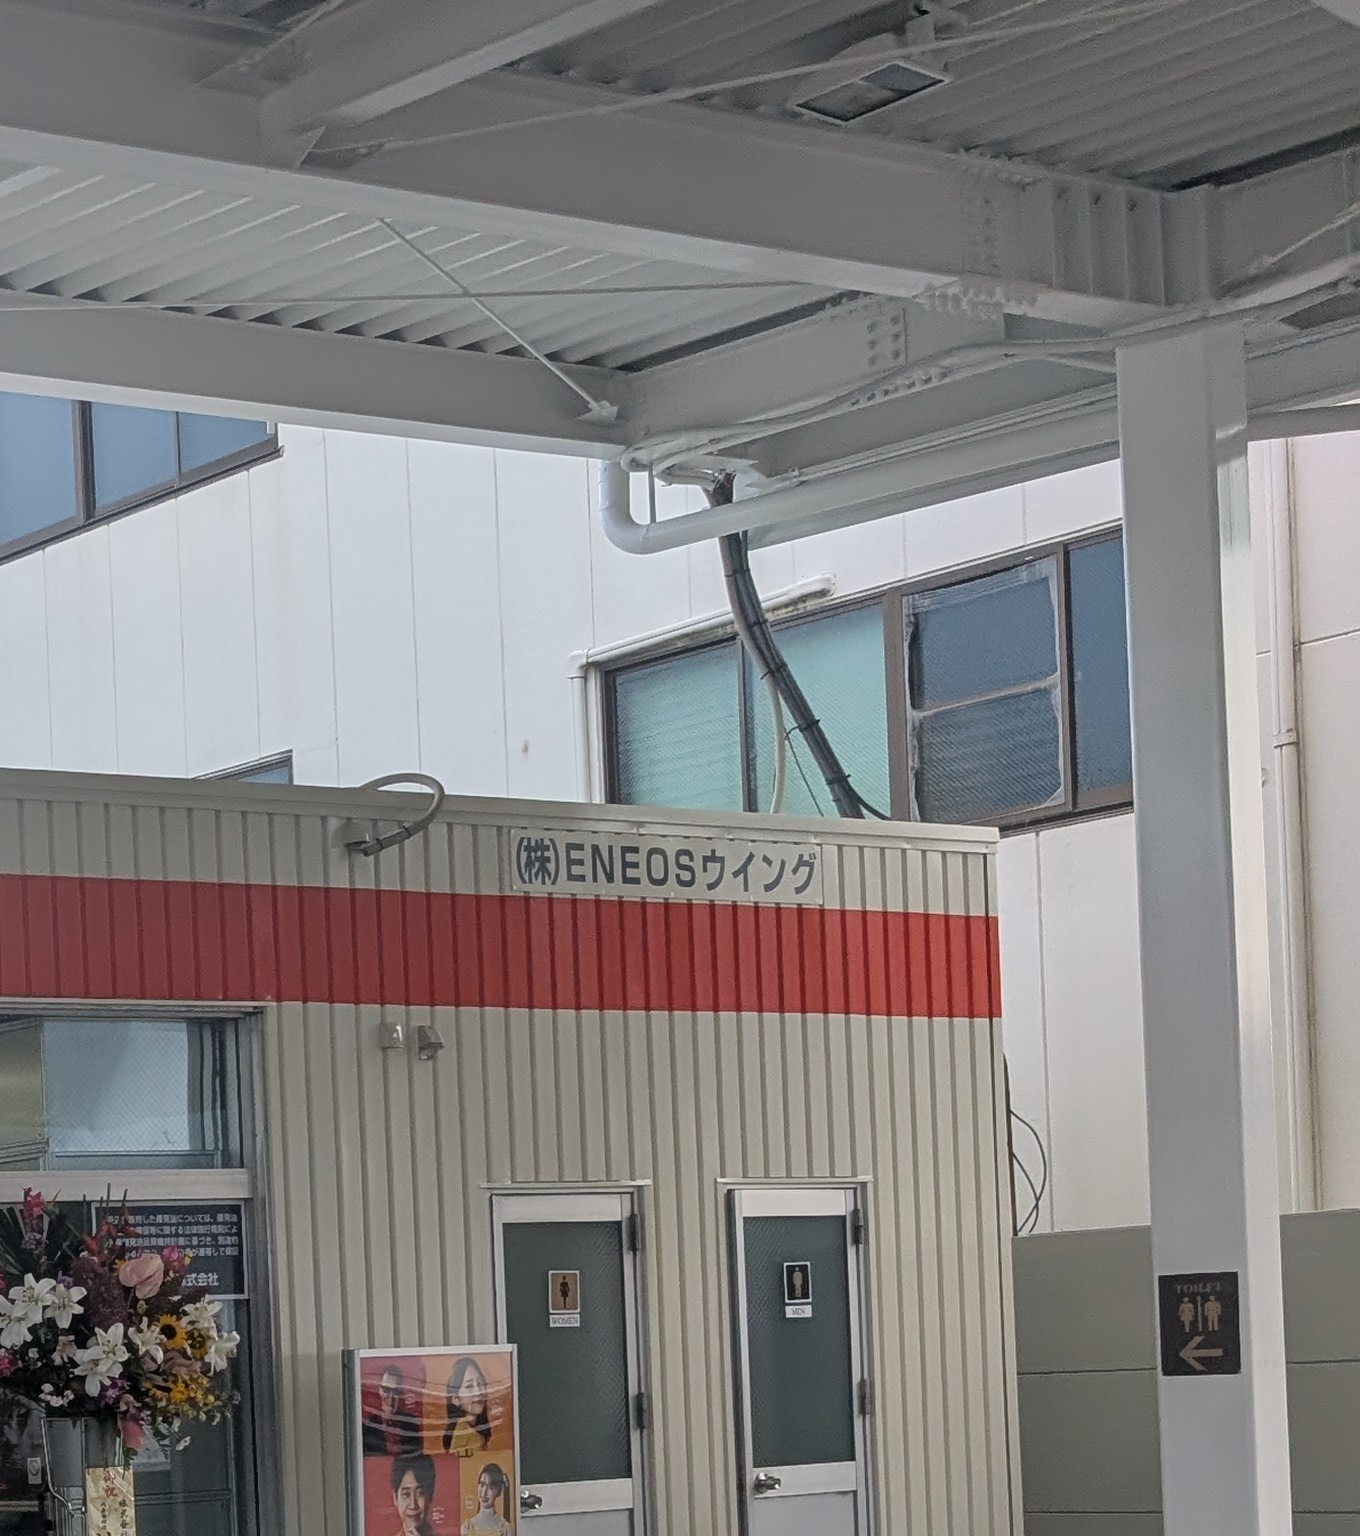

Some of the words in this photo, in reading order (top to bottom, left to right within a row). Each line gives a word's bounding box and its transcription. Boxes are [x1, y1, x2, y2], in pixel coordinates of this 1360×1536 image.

[516, 836, 817, 895] (株)ENEOSウイング
